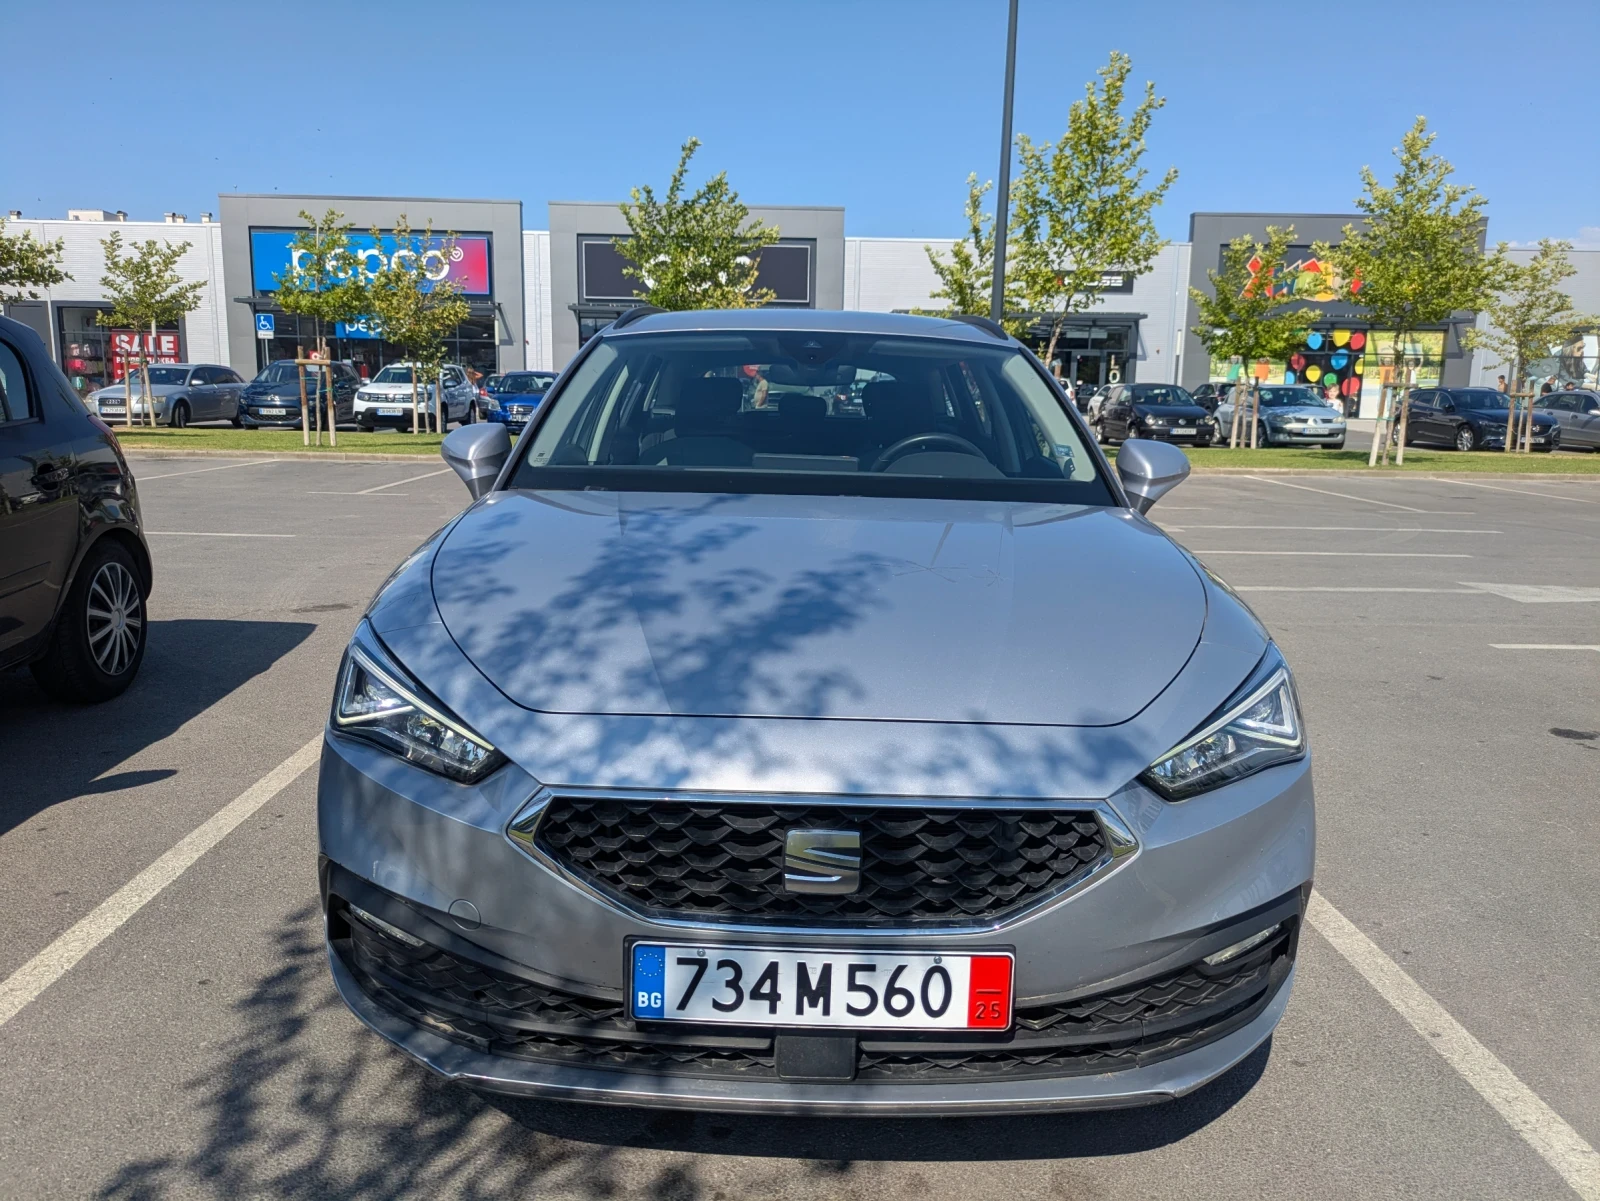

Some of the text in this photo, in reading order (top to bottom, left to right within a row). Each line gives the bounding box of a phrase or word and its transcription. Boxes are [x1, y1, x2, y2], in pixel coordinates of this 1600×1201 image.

[115, 334, 176, 355] SALE
[637, 991, 662, 1008] BG
[975, 1000, 1001, 1019] 25
